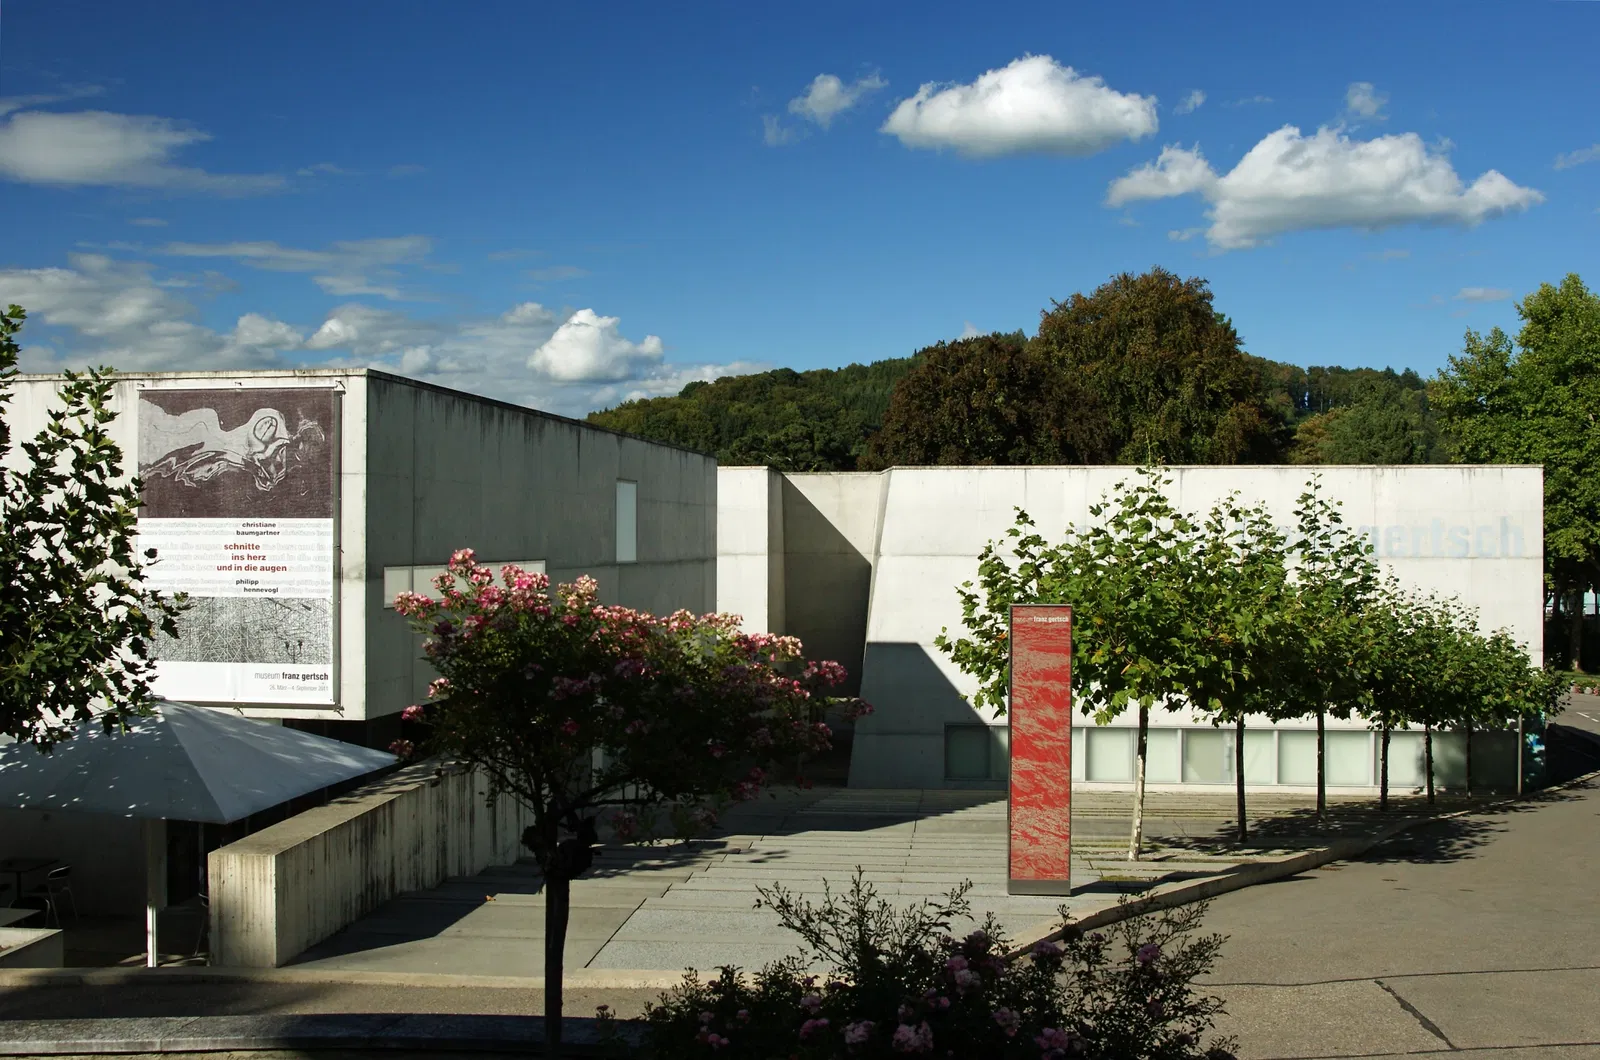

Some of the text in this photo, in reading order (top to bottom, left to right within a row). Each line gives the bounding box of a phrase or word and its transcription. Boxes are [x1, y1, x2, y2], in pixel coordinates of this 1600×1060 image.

[235, 529, 281, 537] baumgartner
[223, 542, 261, 551] schnitte
[231, 552, 246, 561] ins
[246, 553, 267, 561] herz
[216, 563, 233, 572] und
[233, 563, 243, 572] in
[243, 563, 259, 572] die
[259, 565, 288, 574] augen
[235, 578, 260, 586] philipp
[243, 586, 279, 595] hennevogl
[254, 671, 329, 682] museum franz gertsch
